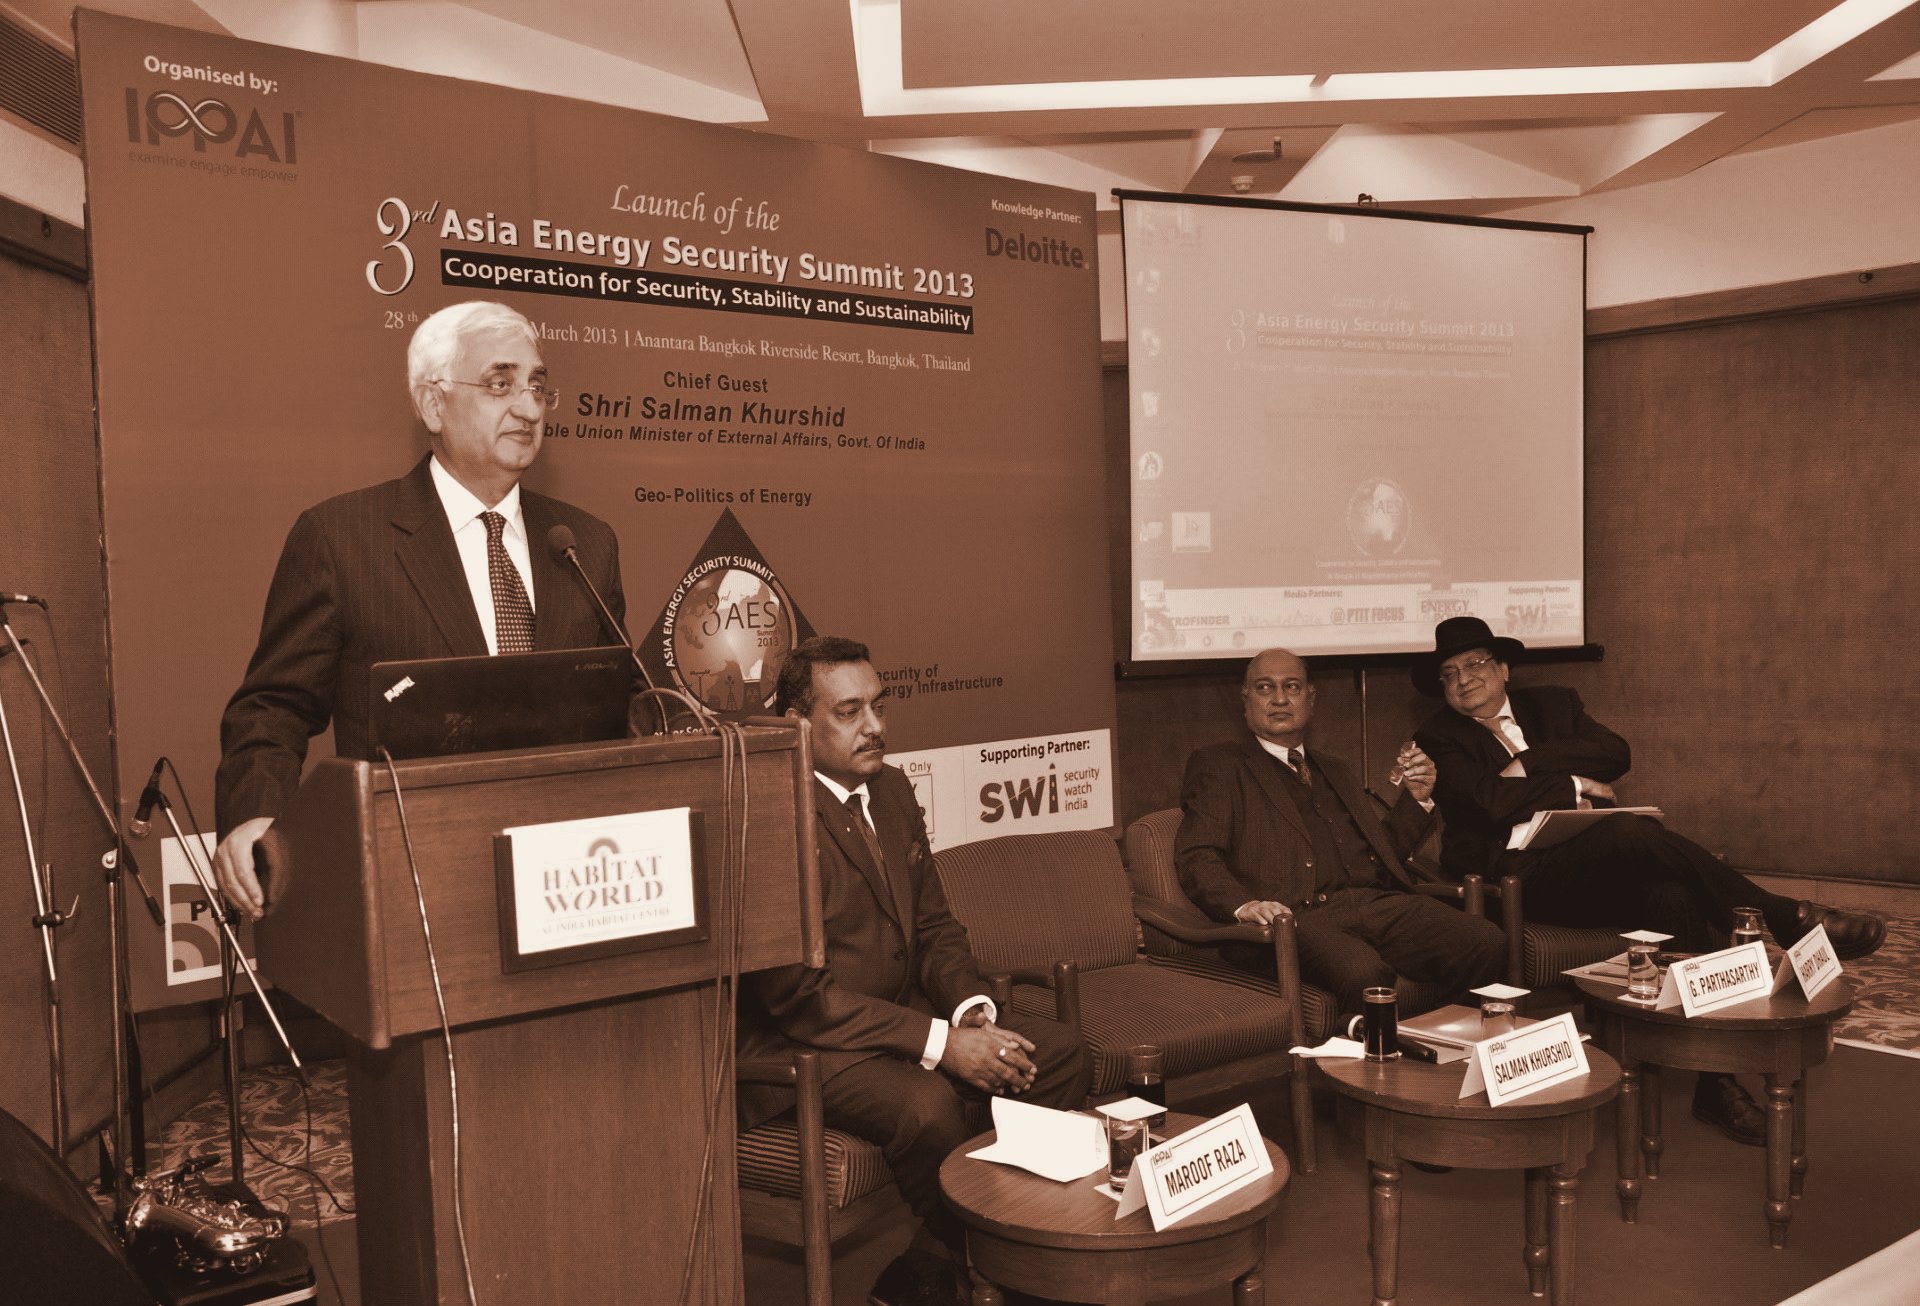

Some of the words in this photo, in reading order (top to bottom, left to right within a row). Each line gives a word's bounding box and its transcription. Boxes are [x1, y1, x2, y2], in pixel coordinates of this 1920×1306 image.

[144, 55, 245, 87] Organised
[250, 73, 278, 95] by:
[125, 87, 297, 165] IPPAI
[128, 151, 186, 168] examine
[190, 159, 238, 178] engage
[240, 165, 298, 182] empower
[610, 184, 706, 222] Launch
[713, 197, 743, 235] of
[745, 200, 780, 232] the
[991, 199, 1044, 220] Knowledge
[1045, 207, 1082, 224] Partner:
[440, 208, 519, 248] Asia
[532, 219, 652, 268] Energy
[662, 236, 791, 283] Security
[799, 253, 906, 293] Summit
[913, 267, 975, 299] 2013
[444, 257, 594, 290] Cooperation
[599, 272, 631, 295] for
[636, 276, 727, 306] Security,
[731, 287, 812, 315] Stability
[816, 296, 851, 315] and
[855, 300, 971, 331] Sustainability
[1256, 312, 1290, 328] Asia
[1295, 314, 1348, 333] Energy
[1353, 317, 1415, 336] Security
[1419, 319, 1475, 336] Summit
[1480, 321, 1515, 338] 2013
[384, 310, 405, 330] 28
[531, 321, 578, 341] March
[583, 325, 617, 344] 2013
[633, 330, 695, 352] Anantara
[699, 334, 756, 359] Bangkok
[760, 339, 819, 361] Riverside
[822, 344, 864, 365] Resort,
[867, 349, 920, 371] Bangkok,
[922, 353, 971, 372] Thailand
[663, 370, 712, 390] Chief
[717, 373, 769, 394] Guest
[576, 392, 631, 420] Shri
[640, 395, 732, 423] Salman
[741, 401, 846, 428] Khurshid
[576, 424, 624, 440] Union
[629, 426, 693, 443] Minister
[698, 428, 713, 444] of
[718, 430, 777, 446] External
[782, 432, 832, 450] Affairs,
[837, 434, 872, 449] Govt.
[876, 435, 892, 449] Of
[895, 436, 925, 451] India
[740, 488, 756, 504] of
[760, 489, 812, 507] Energy
[683, 555, 731, 589] SECURITY
[732, 555, 775, 582] SUMMIT
[663, 584, 686, 635] ENERGY
[725, 601, 777, 630] AES
[663, 637, 676, 668] ASIA
[757, 637, 779, 648] 2013
[876, 666, 920, 682] ecurity
[925, 664, 939, 678] of
[884, 685, 913, 698] ergy
[918, 676, 1004, 694] Infrastructure
[909, 762, 932, 773] Only
[980, 744, 1045, 764] Supporting
[1047, 740, 1090, 754] Partner:
[1064, 766, 1100, 782] security
[1064, 781, 1092, 797] watch
[1064, 799, 1088, 812] india
[543, 855, 662, 891] HABITAT
[544, 880, 664, 914] WORLD
[1689, 980, 1700, 997] G.
[1699, 961, 1760, 994] PARTHASARTHY
[1495, 1056, 1530, 1084] SALMAN
[1528, 1040, 1572, 1072] KHURSHID
[1165, 1153, 1213, 1198] MAROOF
[1214, 1138, 1247, 1173] RAZA
